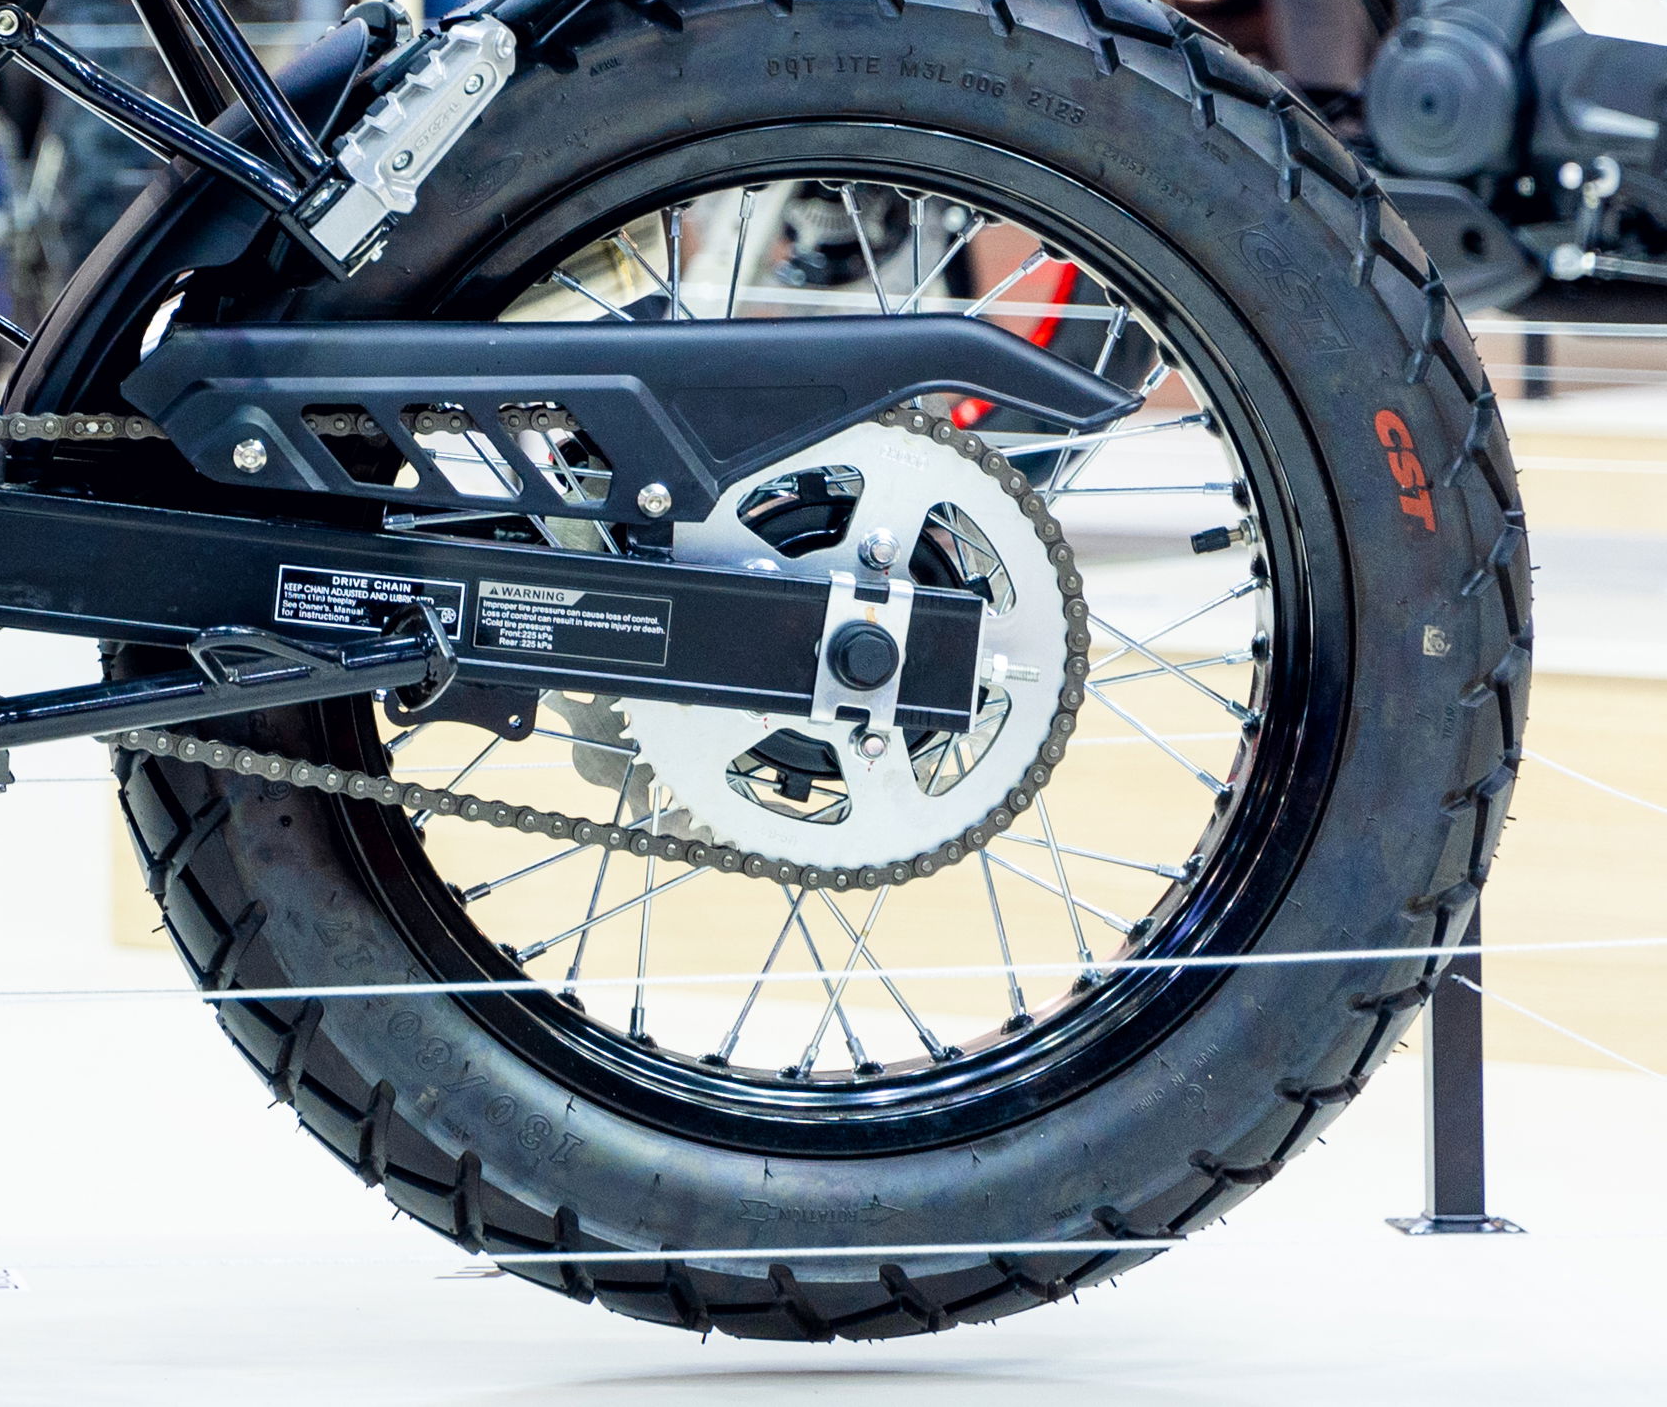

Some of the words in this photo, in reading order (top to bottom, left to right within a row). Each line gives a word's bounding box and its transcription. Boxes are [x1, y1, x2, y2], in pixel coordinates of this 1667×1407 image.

[960, 71, 1009, 99] 006
[1375, 408, 1437, 534] CST
[284, 582, 303, 592] KEEP
[303, 585, 330, 596] CHAIN
[330, 588, 369, 600] ADJUSTED
[369, 592, 388, 601] AND
[332, 576, 368, 589] DRIVE
[373, 581, 412, 593] CHAIN
[283, 591, 307, 601] 15mm
[327, 596, 357, 607] freeplay
[501, 586, 566, 602] WARNING
[281, 608, 294, 617] for
[298, 610, 350, 623] instructions
[282, 600, 298, 609] See
[334, 605, 364, 616] Manual
[482, 599, 517, 611] Improper
[518, 602, 531, 612] tire
[532, 604, 566, 616] pressure
[566, 608, 581, 618] can
[581, 610, 605, 619] cause
[606, 612, 621, 621] loss
[622, 613, 632, 622] of
[632, 615, 660, 625] control.
[482, 609, 500, 618] Loss
[501, 610, 510, 619] of
[510, 611, 537, 622] control
[537, 614, 552, 623] can
[553, 616, 575, 625] result
[575, 618, 583, 626] in
[584, 619, 610, 629] severe
[611, 621, 632, 633] injury
[632, 625, 641, 633] or
[641, 625, 666, 635] death.
[504, 620, 517, 629] tire
[517, 622, 554, 633] pressure:
[499, 637, 518, 648] Rear
[537, 640, 553, 650] kPa
[537, 631, 553, 642] kPa
